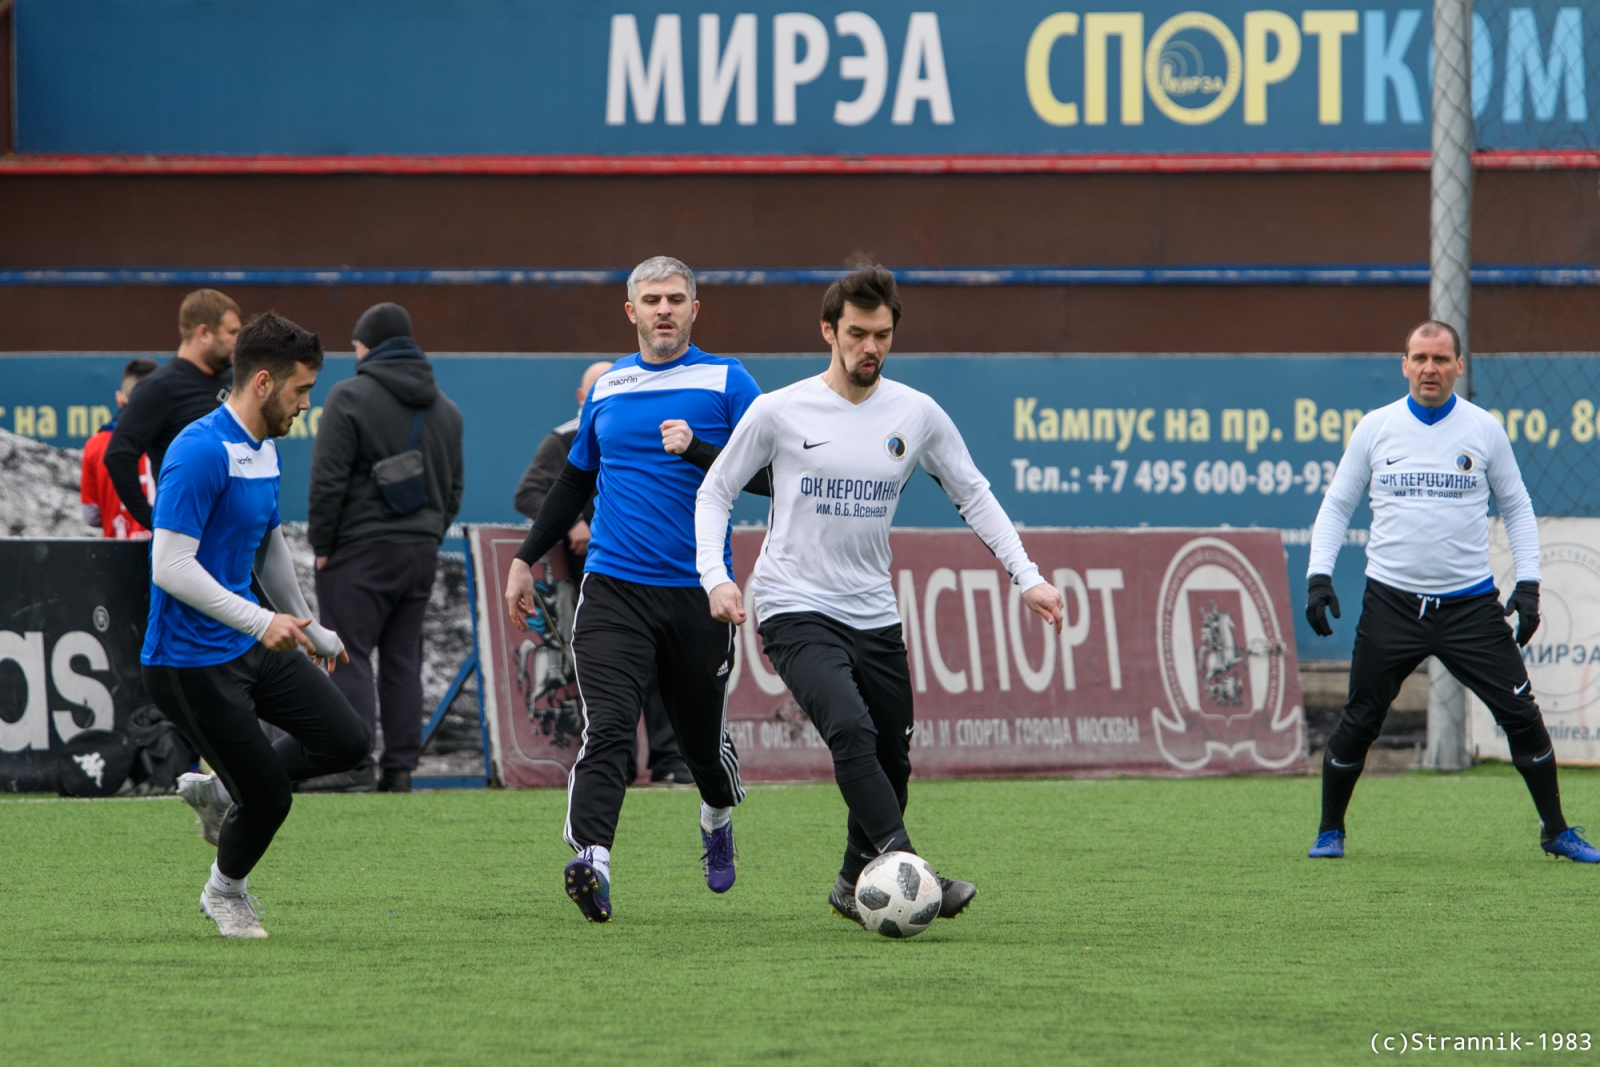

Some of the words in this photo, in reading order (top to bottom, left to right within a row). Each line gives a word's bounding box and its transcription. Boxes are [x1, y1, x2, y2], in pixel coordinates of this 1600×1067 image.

[605, 11, 956, 126] МИРЭА
[14, 405, 57, 437] на
[1013, 397, 1156, 452] Кампус
[1164, 408, 1211, 442] на
[1221, 408, 1283, 453] пр.
[1570, 398, 1600, 443] 8
[800, 476, 824, 497] ФК
[1011, 458, 1081, 494] Тел.:
[1087, 460, 1129, 493] +7
[1133, 460, 1187, 494] 495
[1400, 472, 1478, 490] КЕРОСИНКА
[816, 503, 832, 516] им.
[834, 501, 852, 517] В.Б.
[955, 718, 1011, 748] СПОРТА
[1014, 716, 1072, 749] ГОРОДА
[1075, 715, 1141, 744] МОСКВЫ
